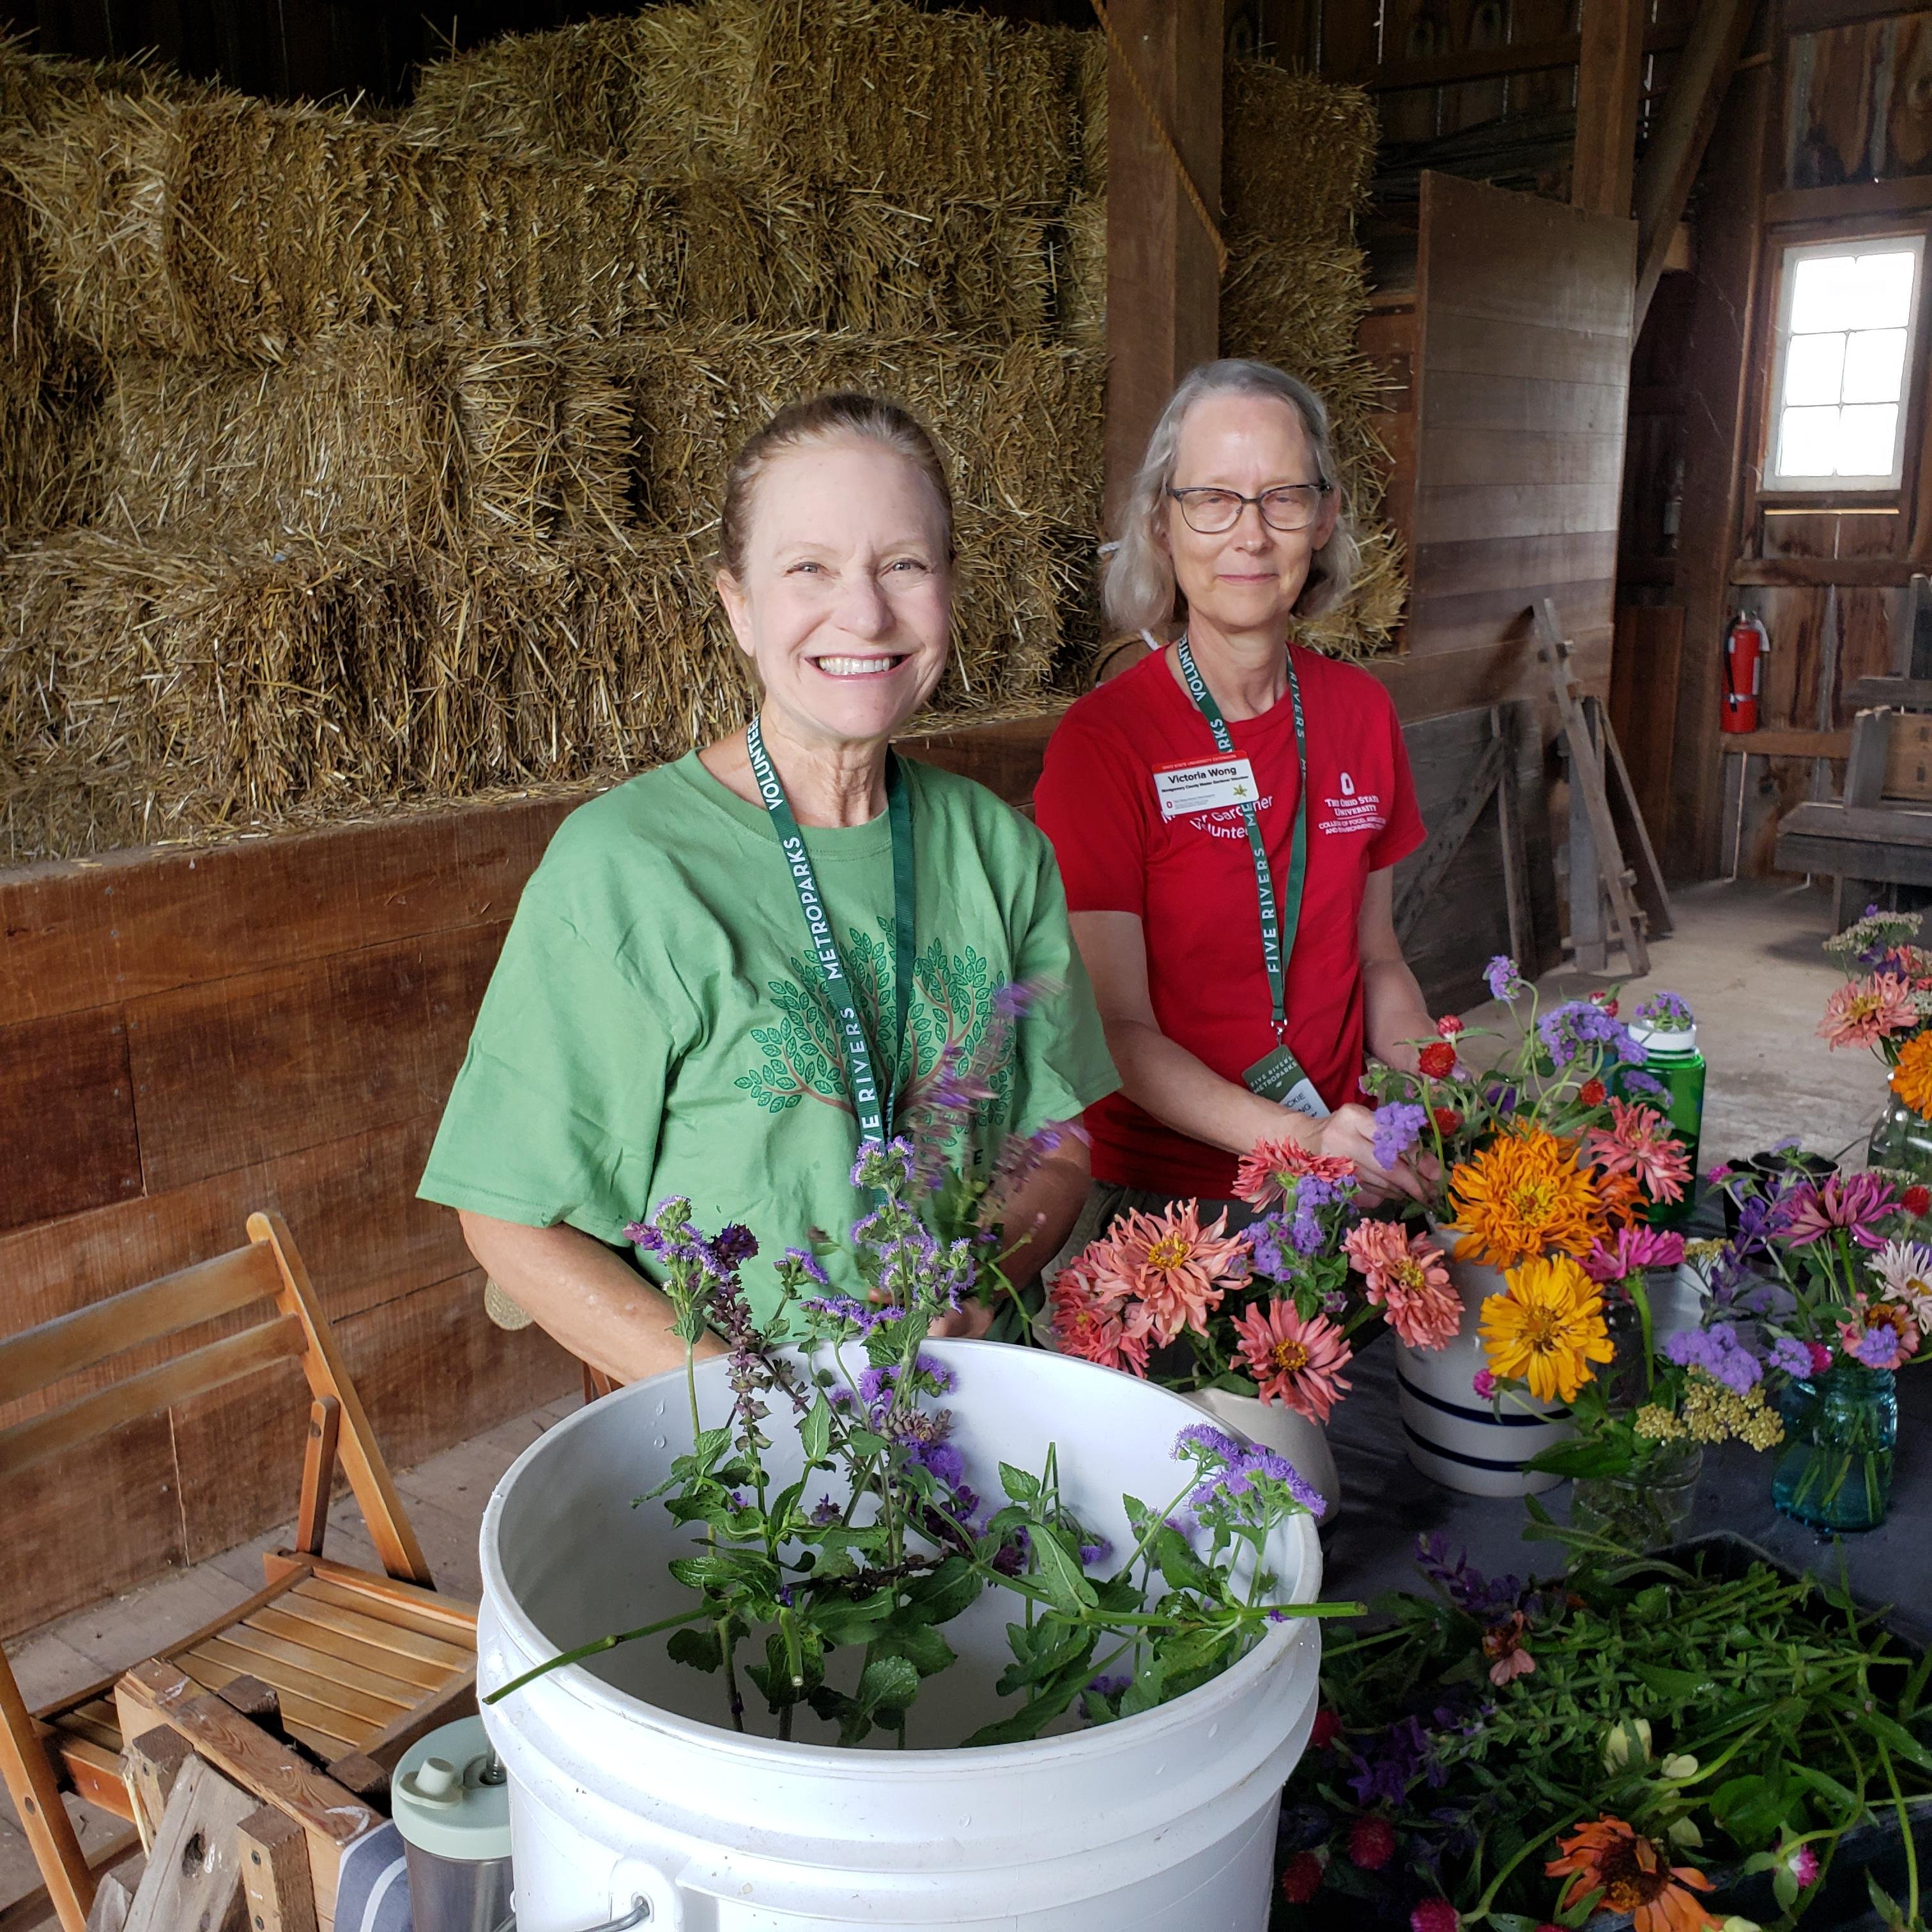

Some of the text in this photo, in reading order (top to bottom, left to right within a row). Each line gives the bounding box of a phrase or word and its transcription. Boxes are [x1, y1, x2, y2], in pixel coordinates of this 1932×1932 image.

[1177, 632, 1206, 702] VOLUNTE
[1168, 767, 1237, 784] Victoria Wong
[783, 836, 843, 981] METROPARKS
[1254, 847, 1275, 920] RIVERS
[1263, 928, 1280, 973] FIVE
[839, 1007, 875, 1103] RIVERS
[1250, 1055, 1293, 1087] FIVE RIVERS
[1254, 1061, 1298, 1094] METROPARKS
